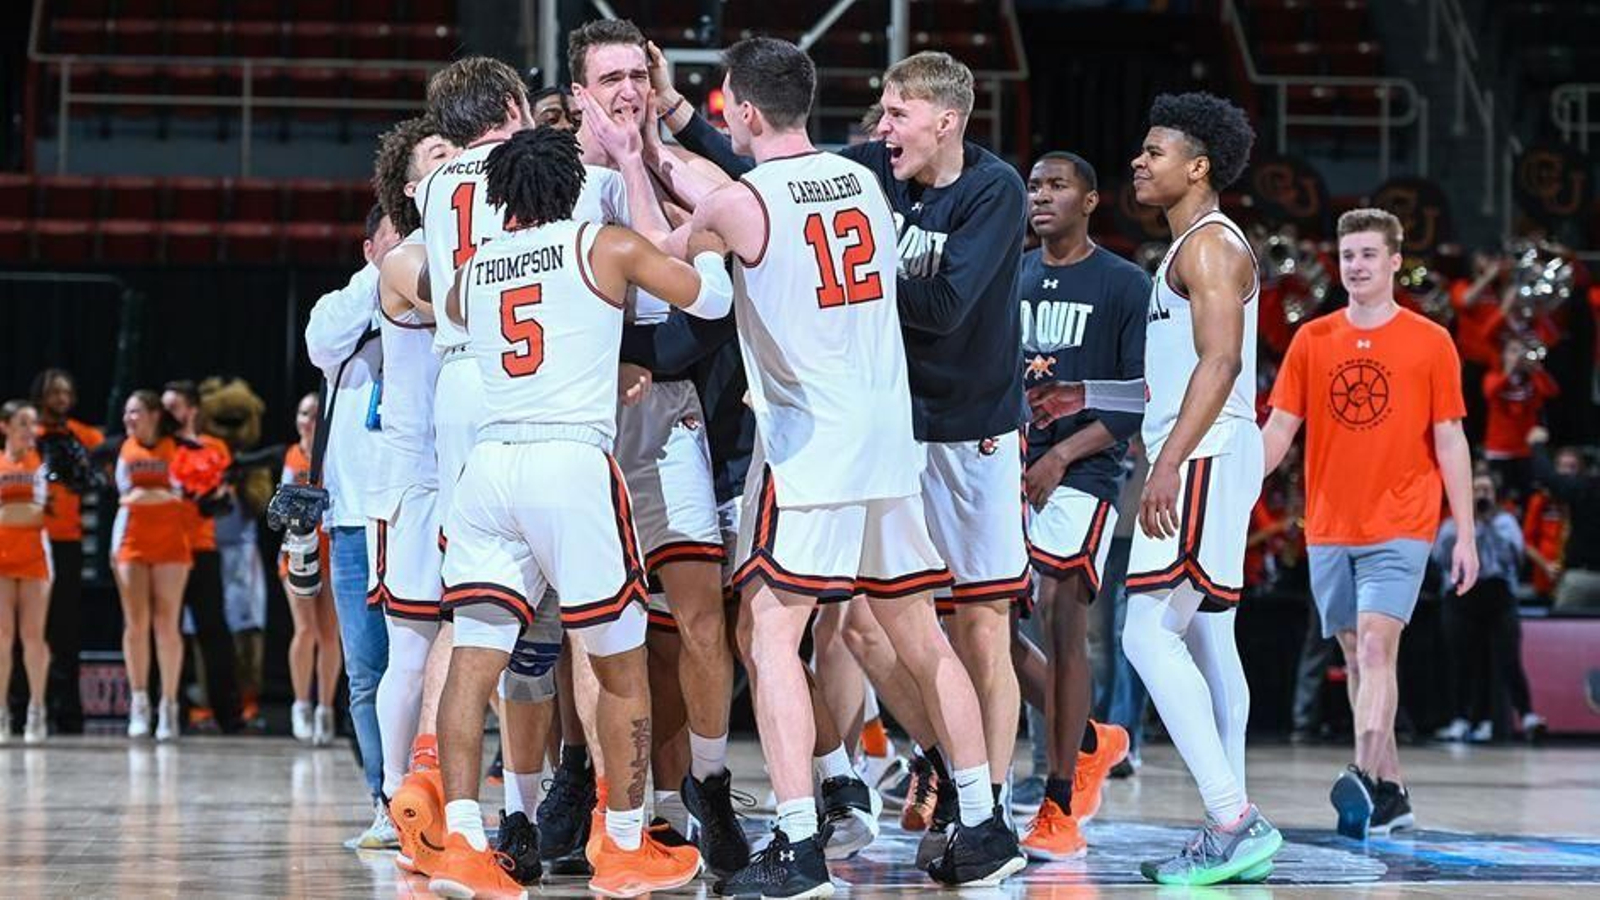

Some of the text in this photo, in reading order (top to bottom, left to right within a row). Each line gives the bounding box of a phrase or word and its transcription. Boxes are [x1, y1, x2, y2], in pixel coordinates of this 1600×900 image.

[443, 160, 488, 175] McCU
[787, 172, 863, 204] CARRALERO
[475, 245, 564, 285] THOMPSON
[804, 207, 883, 309] 12
[500, 283, 544, 378] 5
[1037, 300, 1094, 350] QUIT
